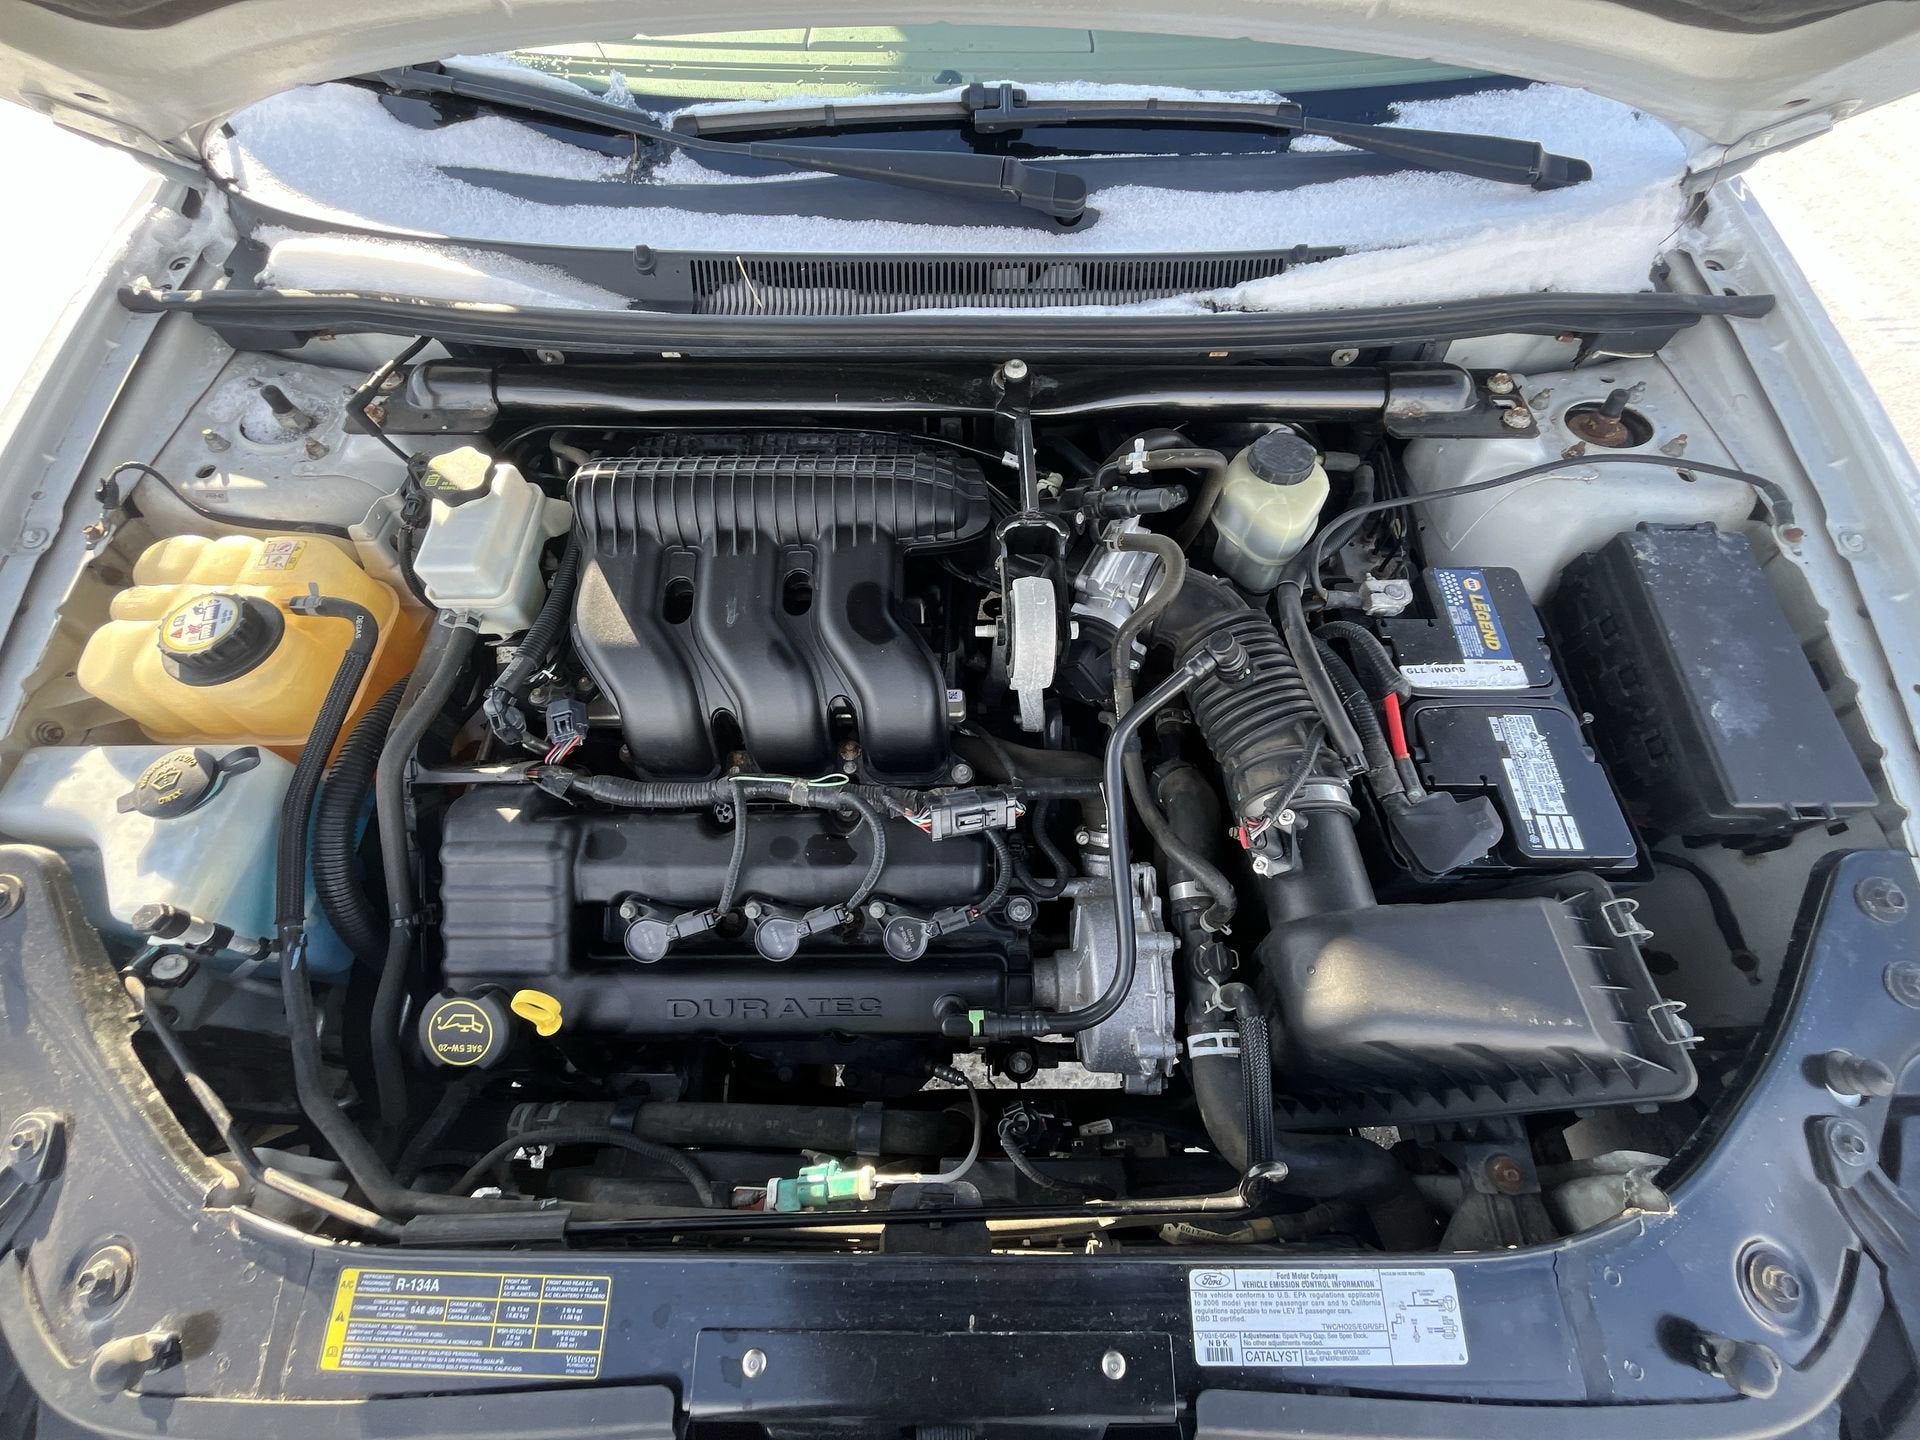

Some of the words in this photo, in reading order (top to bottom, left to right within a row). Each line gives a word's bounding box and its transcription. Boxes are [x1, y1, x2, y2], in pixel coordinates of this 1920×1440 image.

[1469, 593, 1502, 651] LEGEND
[438, 1044, 465, 1053] 5W-20
[466, 1044, 483, 1053] SAE
[1202, 1274, 1223, 1286] Ford
[1277, 1272, 1290, 1280] Ford
[1292, 1272, 1309, 1280] Motor
[1311, 1272, 1338, 1280] Company
[395, 1278, 440, 1291] R-134A
[410, 1306, 425, 1315] SAE
[565, 1354, 596, 1364] Visteon
[1245, 1351, 1299, 1362] CATALYST
